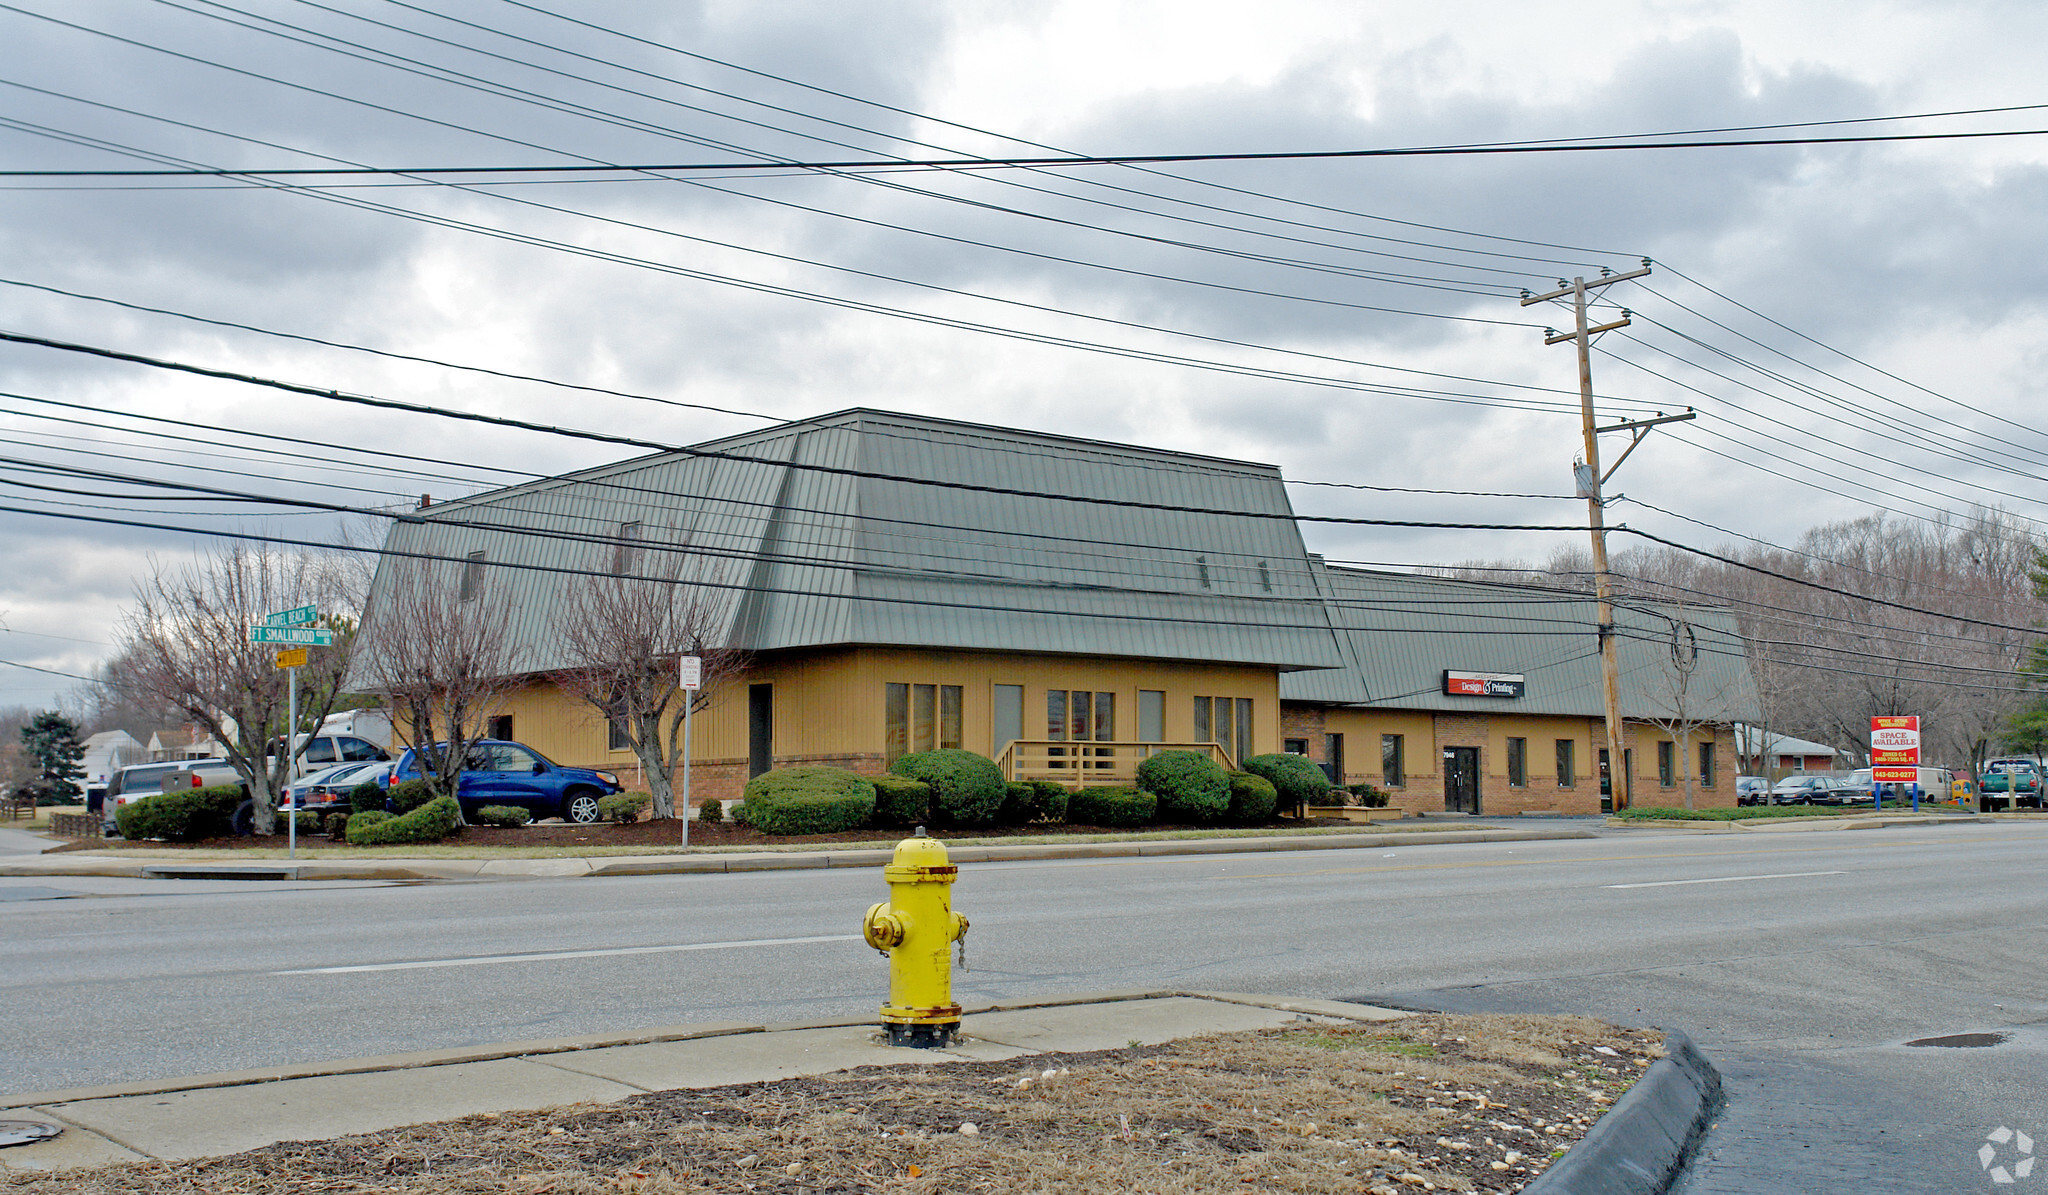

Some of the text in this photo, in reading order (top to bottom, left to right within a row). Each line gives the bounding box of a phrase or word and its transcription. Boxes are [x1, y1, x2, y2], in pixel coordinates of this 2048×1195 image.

[288, 609, 306, 624] BEACH
[251, 627, 262, 640] FT
[265, 628, 315, 642] SMALLWOOD
[1462, 680, 1513, 695] Design & Printing
